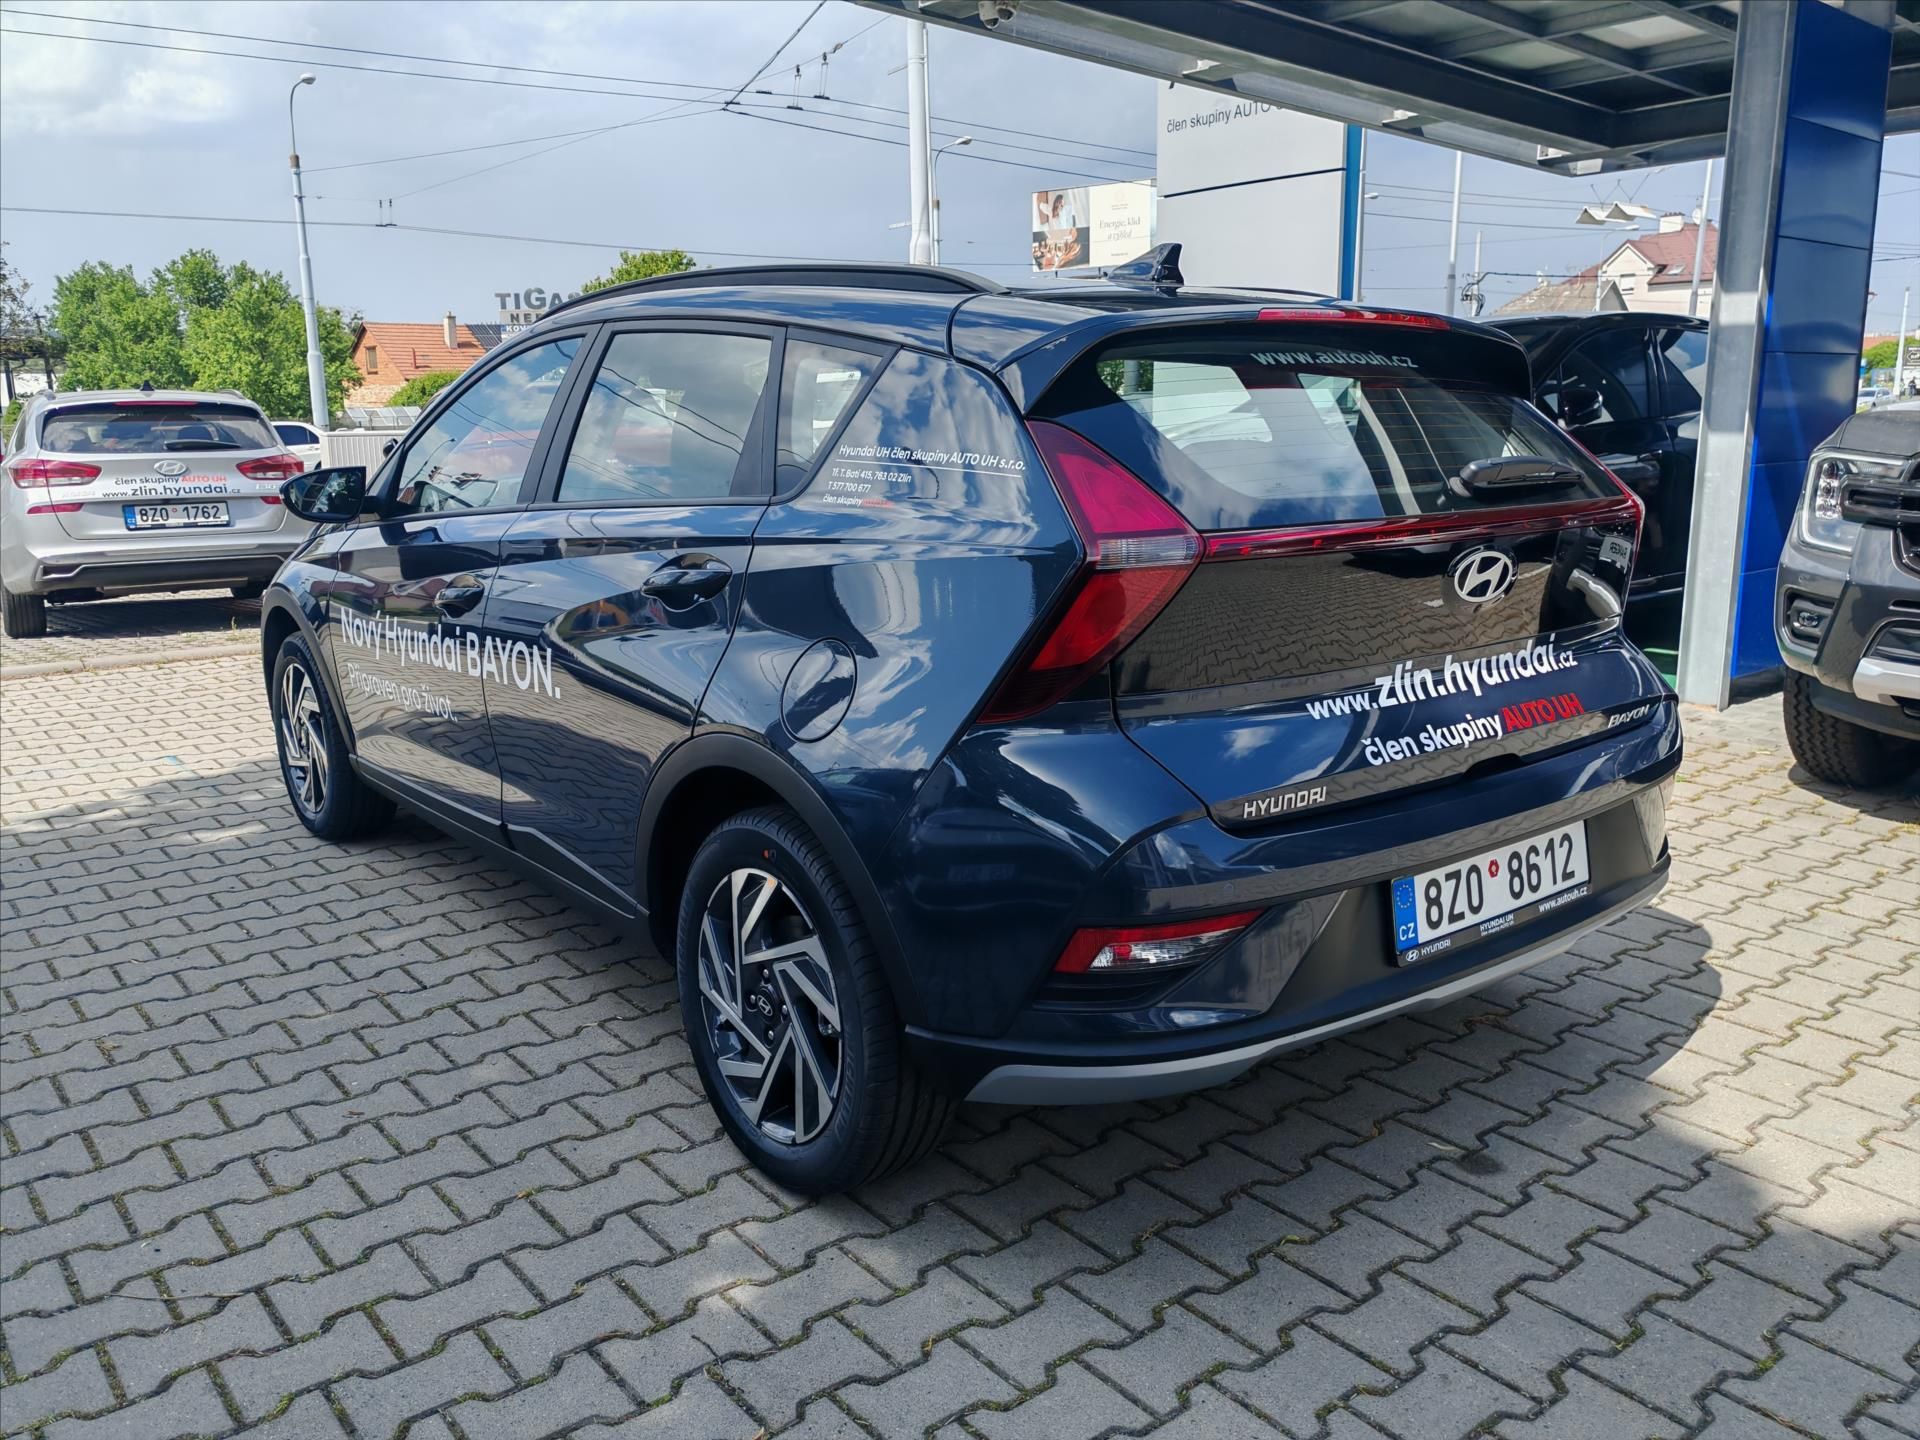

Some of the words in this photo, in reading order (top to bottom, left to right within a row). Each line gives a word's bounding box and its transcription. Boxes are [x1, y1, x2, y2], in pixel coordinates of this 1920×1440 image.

[1166, 119, 1187, 133] člen
[1190, 108, 1232, 128] skupiny
[1250, 350, 1419, 368] www.autouh.cz
[838, 444, 876, 458] Hyundai
[876, 446, 890, 457] UH
[891, 447, 911, 460] člen
[911, 449, 949, 465] skupiny
[949, 452, 980, 466] AUTO
[980, 455, 998, 467] UH
[998, 458, 1026, 471] s.r.o.
[102, 484, 241, 498] www.zlin.hyundai.cz
[114, 475, 138, 487] člen
[139, 475, 180, 485] skupiny
[181, 475, 210, 483] AUTO
[211, 475, 228, 483] UH
[139, 507, 170, 523] 8Z0
[182, 505, 221, 521] 1762
[340, 607, 382, 660] Nový
[385, 615, 462, 673] Hyundai
[466, 631, 561, 699] BAYON.
[1306, 634, 1578, 720] www.zlin.hyundai.cz
[347, 663, 402, 702] Připraven
[400, 685, 422, 713] pro
[421, 683, 458, 723] život.
[1361, 737, 1421, 766] člen
[1422, 714, 1503, 749] skupiny
[1500, 700, 1555, 733] AUTO
[1557, 692, 1586, 717] UH
[1608, 704, 1651, 729] BAYON
[1243, 786, 1327, 819] HYUNDAI
[1424, 863, 1485, 931] 8Z0
[1507, 832, 1576, 901] 8612
[1538, 885, 1589, 914] www.autouh.cz
[1399, 922, 1416, 941] CZ
[1479, 915, 1506, 932] HYUNDAI
[1420, 938, 1451, 957] HYUNDAI
